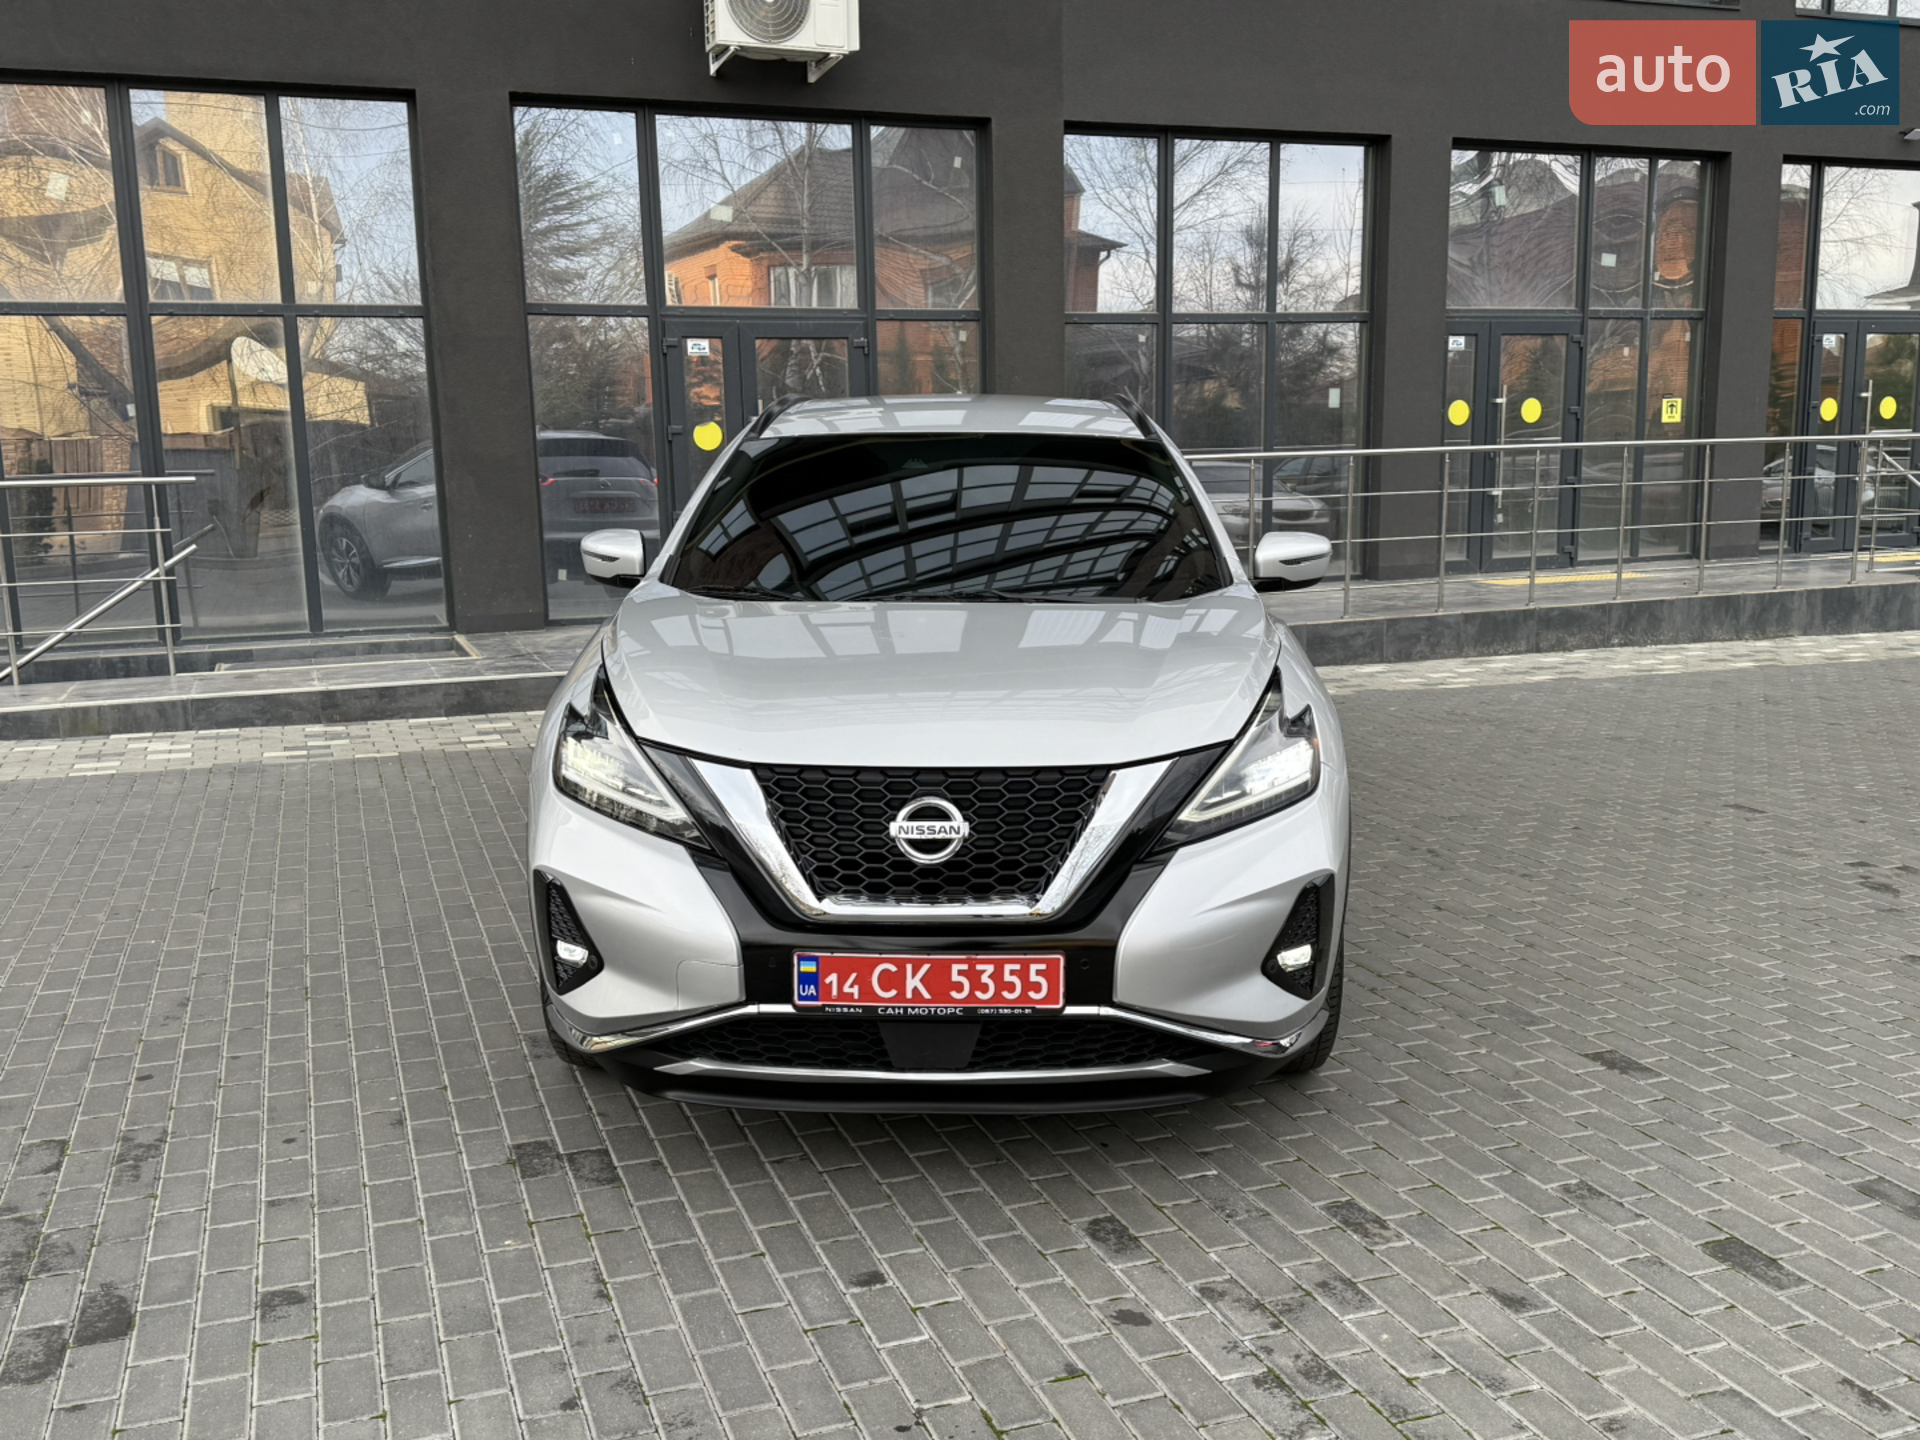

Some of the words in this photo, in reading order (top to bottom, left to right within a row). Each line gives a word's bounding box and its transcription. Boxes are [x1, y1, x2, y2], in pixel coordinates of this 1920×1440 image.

[898, 825, 961, 836] NISSAN
[824, 972, 860, 1000] 14
[871, 962, 932, 999] CK
[949, 963, 1049, 1001] 5355
[799, 984, 817, 997] UA
[877, 1007, 904, 1015] САН
[907, 1007, 964, 1016] МОТОРС
